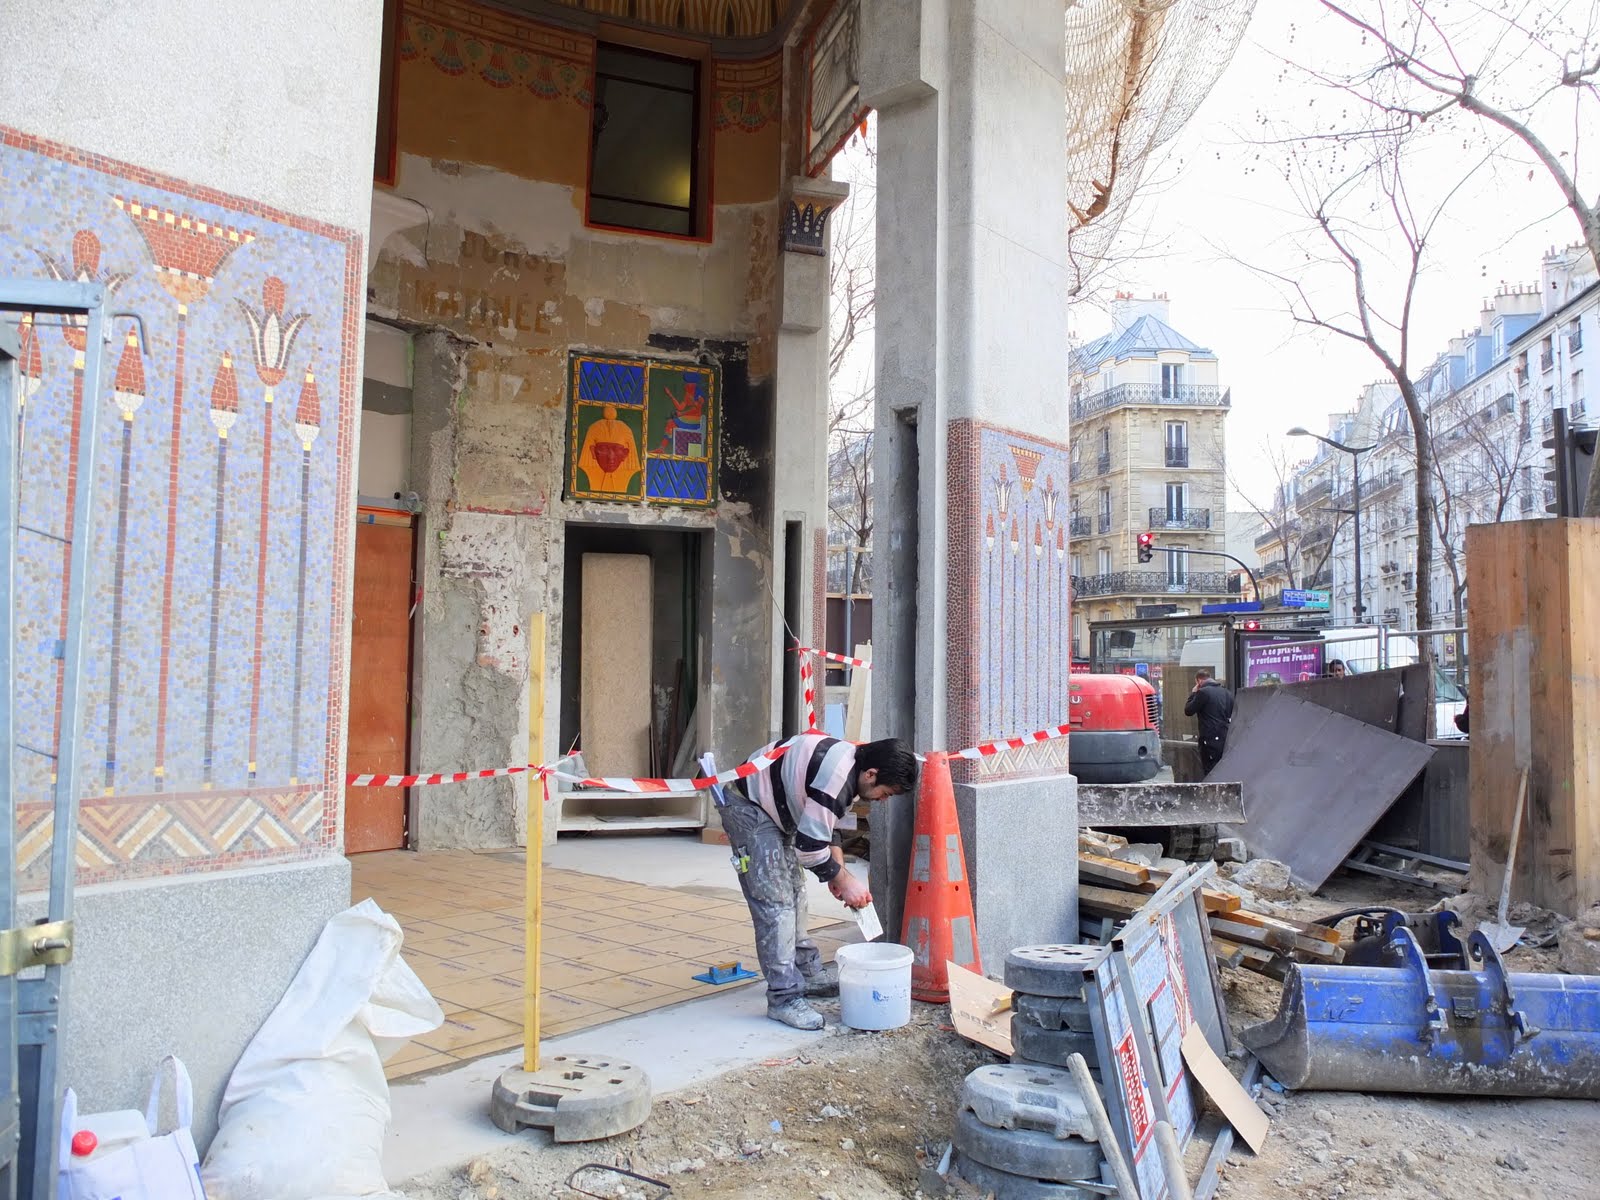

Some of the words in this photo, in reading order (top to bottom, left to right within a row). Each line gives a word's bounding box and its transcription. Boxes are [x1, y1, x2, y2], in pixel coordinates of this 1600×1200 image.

[1256, 656, 1281, 665] reviens
[1282, 655, 1290, 663] en
[1121, 1052, 1140, 1136] CHANTIER
[1126, 1053, 1142, 1127] INTERDIT
[1128, 1039, 1142, 1098] PUBLIC
[1139, 1102, 1147, 1124] AU
